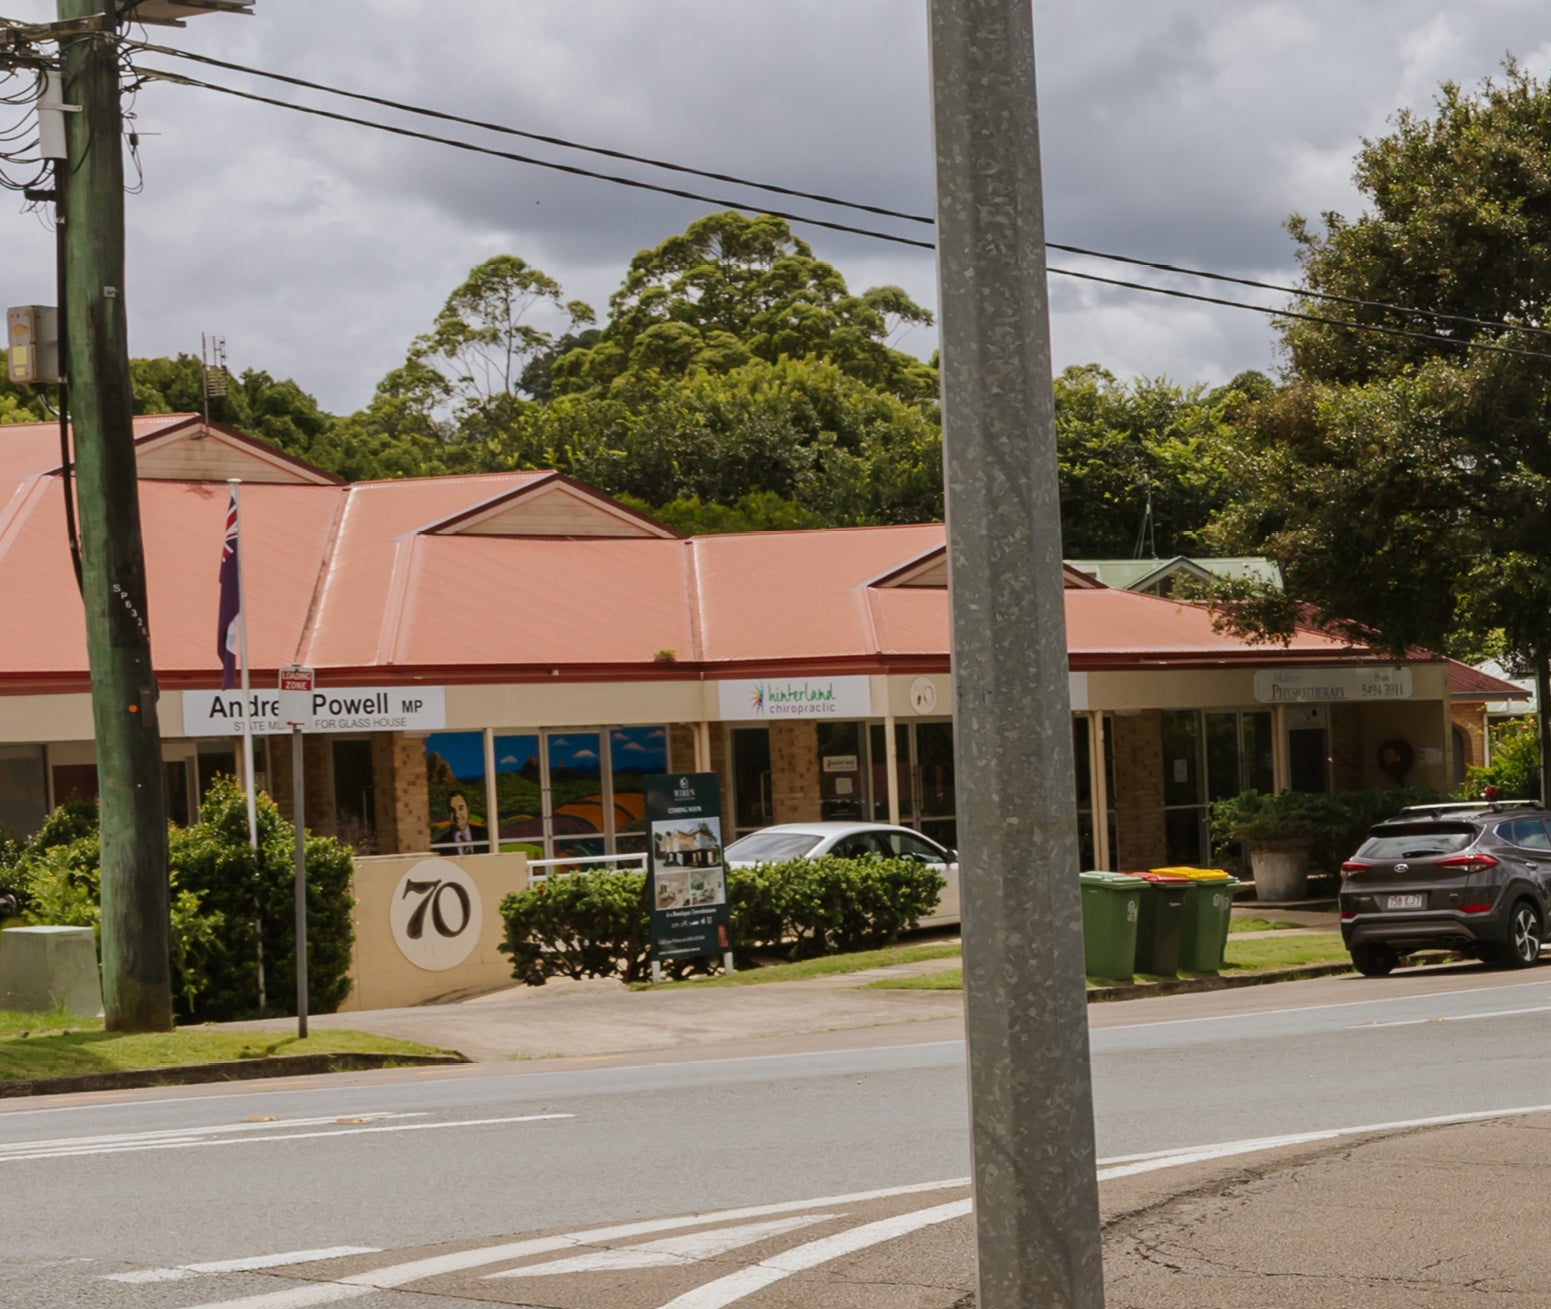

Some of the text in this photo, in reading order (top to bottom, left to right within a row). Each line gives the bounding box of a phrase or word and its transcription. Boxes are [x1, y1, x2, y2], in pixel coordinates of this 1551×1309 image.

[281, 671, 312, 680] LOADING
[285, 680, 308, 690] ZONE
[768, 683, 836, 702] hinterland
[209, 693, 424, 719] Andre Powell MP
[769, 702, 836, 714] chiropractic
[315, 717, 408, 729] FOR GLASS HOUSE
[402, 878, 471, 940] 70
